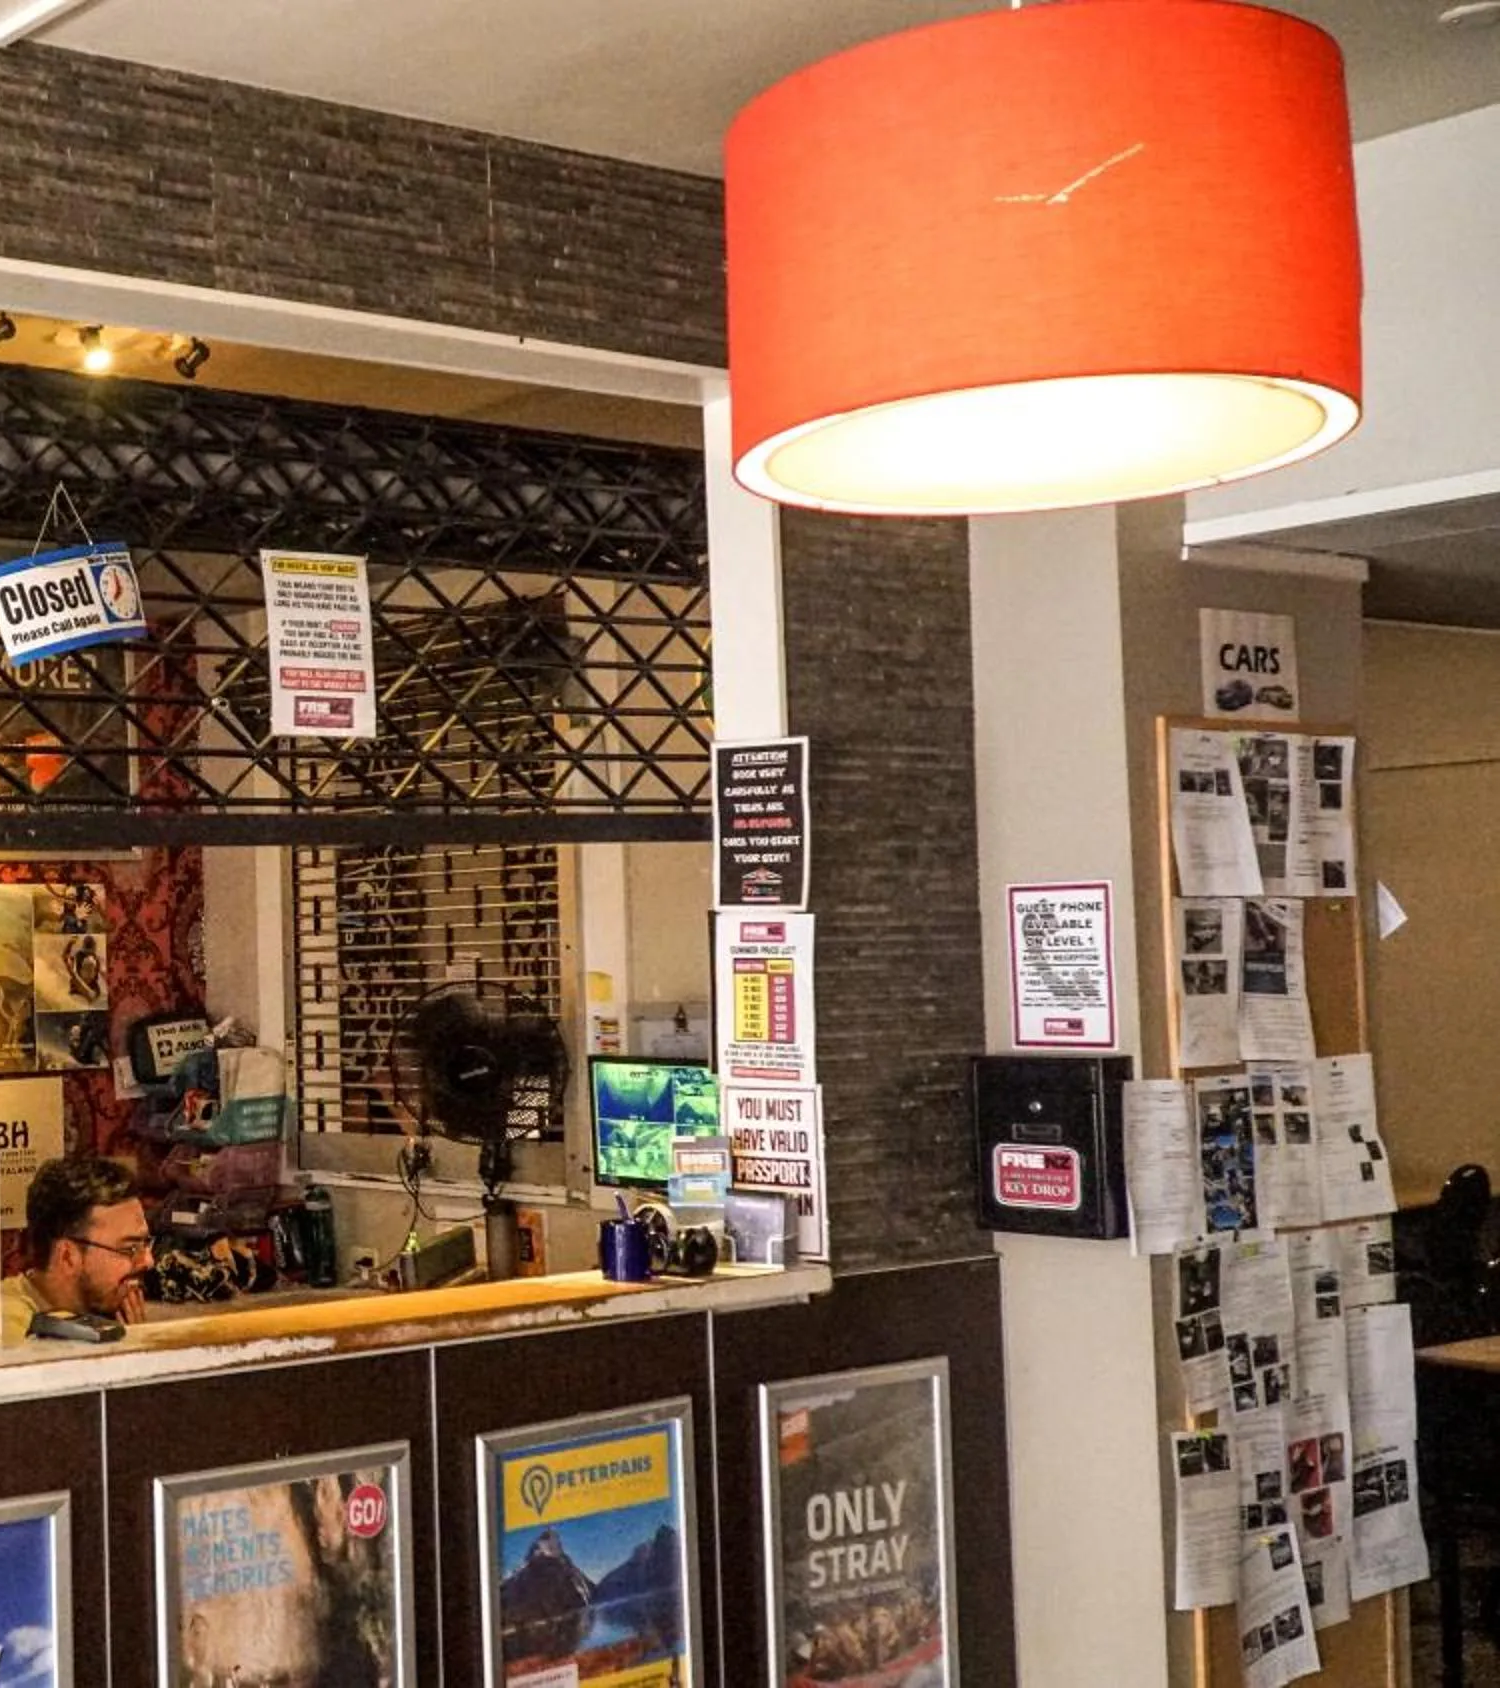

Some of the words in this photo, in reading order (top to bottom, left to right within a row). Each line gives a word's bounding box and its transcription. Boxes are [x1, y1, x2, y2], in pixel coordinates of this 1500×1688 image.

[11, 626, 51, 647] Please
[51, 619, 74, 634] Call
[74, 612, 102, 631] Again
[1219, 643, 1281, 674] CARS
[1016, 902, 1055, 914] GUEST
[1060, 901, 1103, 912] PHONE
[1027, 918, 1093, 929] AVAILABLE
[1026, 937, 1043, 947] ON
[1047, 935, 1084, 947] LEVEL
[736, 1098, 762, 1121] YOU
[765, 1098, 803, 1121] MUST
[734, 1128, 766, 1151] HAVE
[769, 1131, 809, 1154] VALID
[1004, 1181, 1030, 1195] KEY
[1032, 1183, 1071, 1197] DROP
[797, 1193, 815, 1217] IN
[556, 1456, 653, 1491] PETERPANS
[182, 1506, 249, 1537] MATES
[349, 1500, 384, 1528] GO!
[806, 1479, 907, 1542] ONLY
[808, 1534, 910, 1589] STRAY
